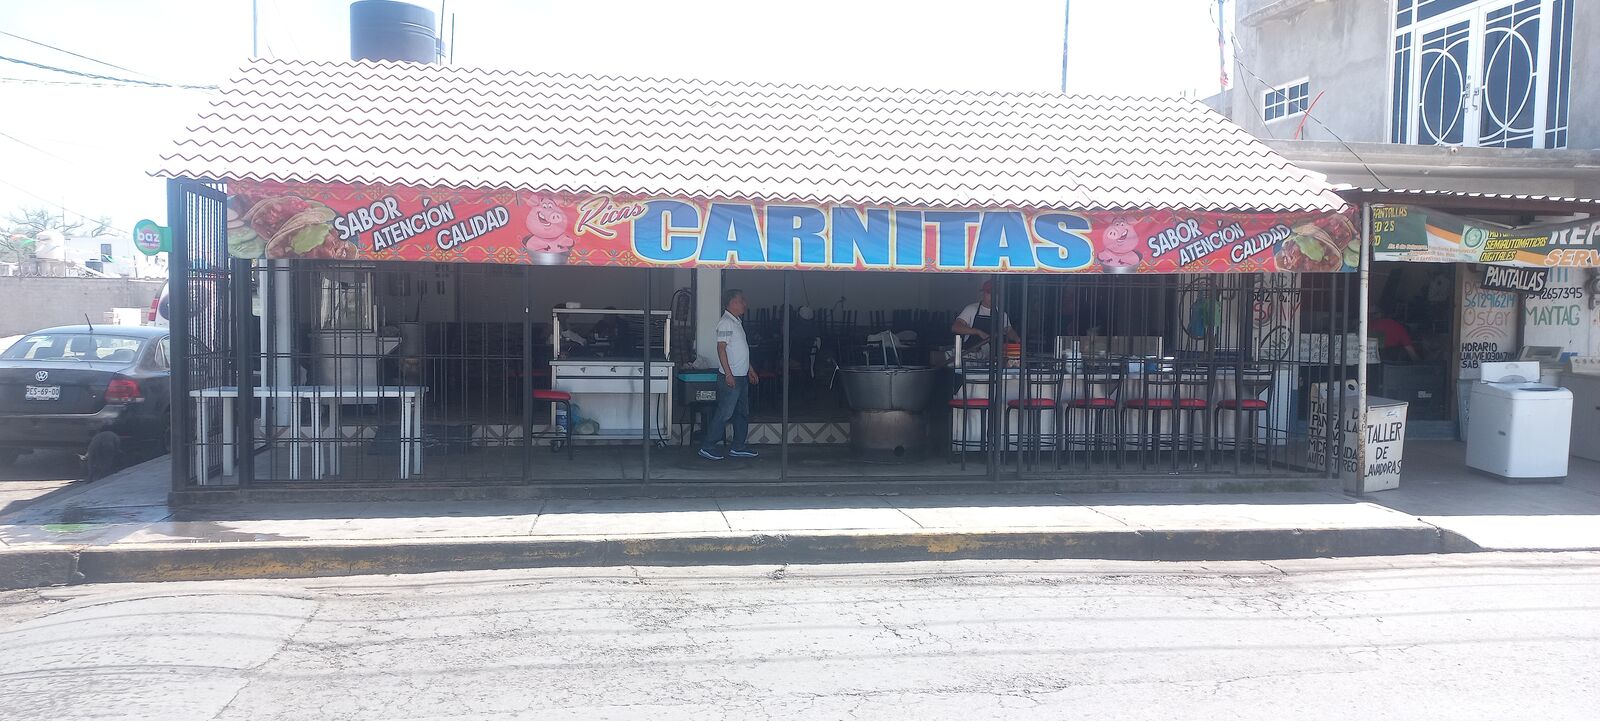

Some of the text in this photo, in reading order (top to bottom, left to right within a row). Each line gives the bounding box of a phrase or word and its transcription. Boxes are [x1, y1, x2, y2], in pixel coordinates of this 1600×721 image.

[334, 197, 402, 240] SABOR
[372, 199, 455, 251] ATENCIÓN
[436, 206, 510, 250] CALIDAD
[578, 197, 1095, 269] Ricas CARNITAS
[1148, 219, 1202, 258] SABOR
[1179, 220, 1245, 266] ATENCIÓN
[1231, 224, 1291, 263] CALIDAD
[1486, 237, 1548, 250] SEMIAUTOMATICAS
[1480, 250, 1517, 262] DIGITALES
[1485, 266, 1545, 292] PANTALLAS
[1463, 308, 1511, 326] Oster
[1524, 305, 1581, 326] MAYTAG
[1461, 342, 1498, 352] HORARIO
[1367, 422, 1402, 444] TALLER
[1375, 446, 1389, 460] DE
